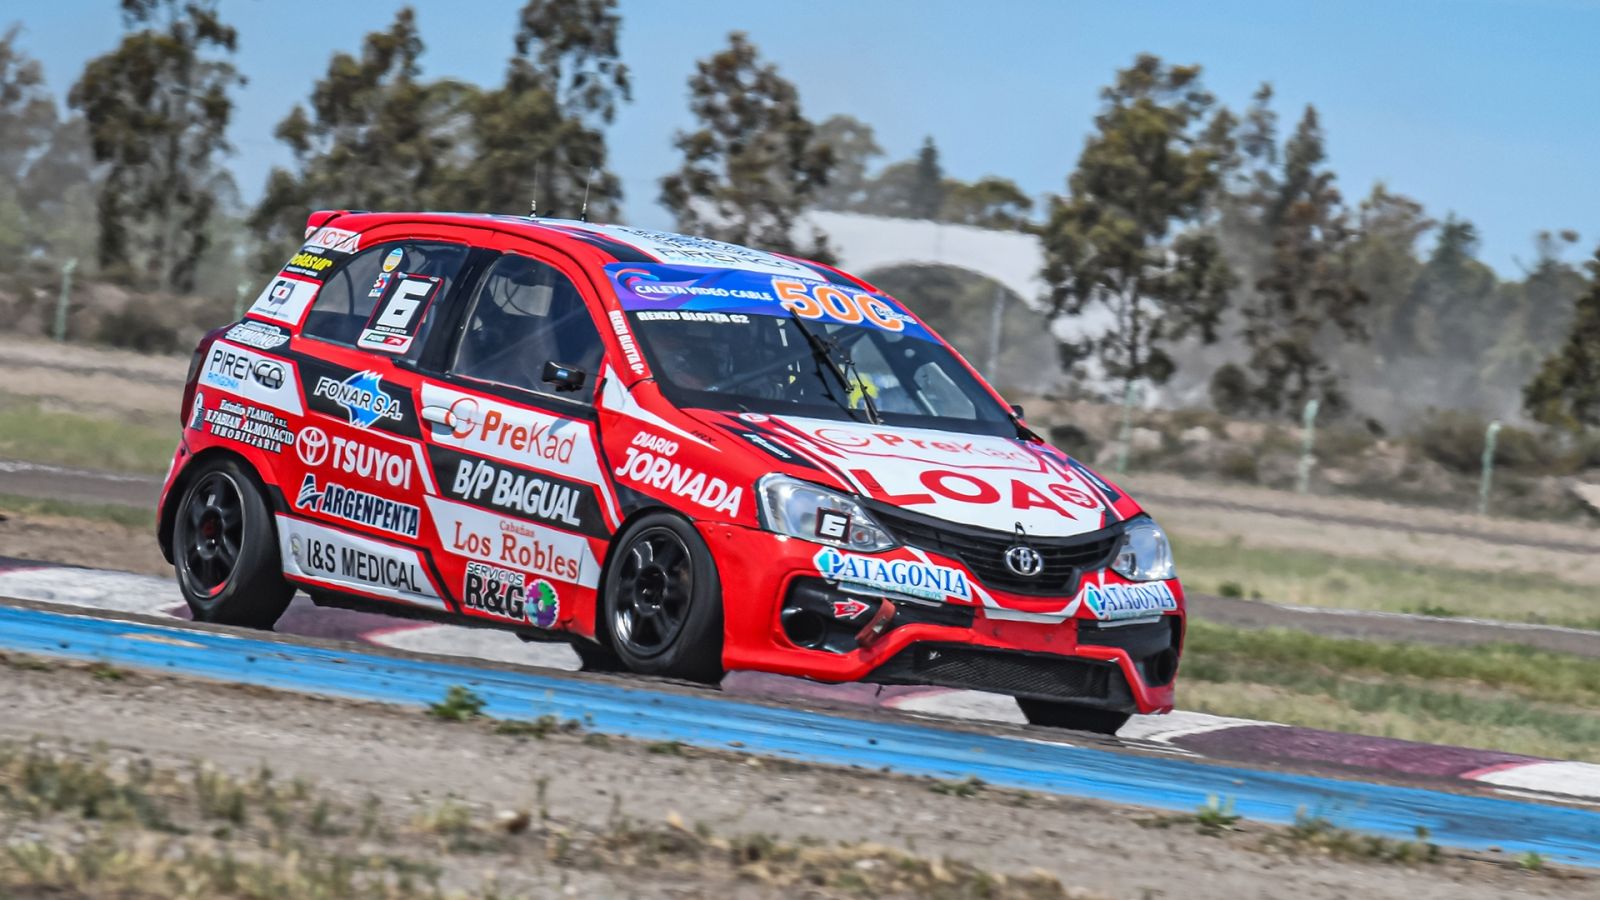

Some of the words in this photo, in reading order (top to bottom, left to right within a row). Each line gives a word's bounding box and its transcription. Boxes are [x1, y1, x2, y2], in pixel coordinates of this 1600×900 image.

[377, 279, 433, 328] 6
[635, 285, 687, 295] CALETA
[687, 287, 729, 297] VIDEO
[730, 289, 774, 301] CABLE
[636, 311, 681, 321] RENZO
[313, 377, 371, 412] FONAR
[373, 395, 403, 420] S.A.
[241, 420, 295, 446] ALMONACID
[480, 409, 577, 465] PreKad
[632, 431, 679, 457] DIARIO
[872, 432, 1037, 465] PreKad
[332, 436, 412, 490] TSUYOI
[615, 447, 743, 518] JORNADA
[320, 483, 419, 538] ARGENPENTA
[452, 459, 495, 500] B/P
[492, 470, 581, 526] BAGUAL
[500, 520, 535, 538] Cabañas
[820, 513, 848, 538] 6
[307, 538, 336, 573] I&S
[342, 547, 422, 593] MEDICAL
[453, 521, 492, 557] Los
[500, 533, 578, 579] Robles
[465, 573, 525, 619] R&G
[466, 562, 524, 586] SERVICIOS
[830, 550, 969, 597] PATAGONIA
